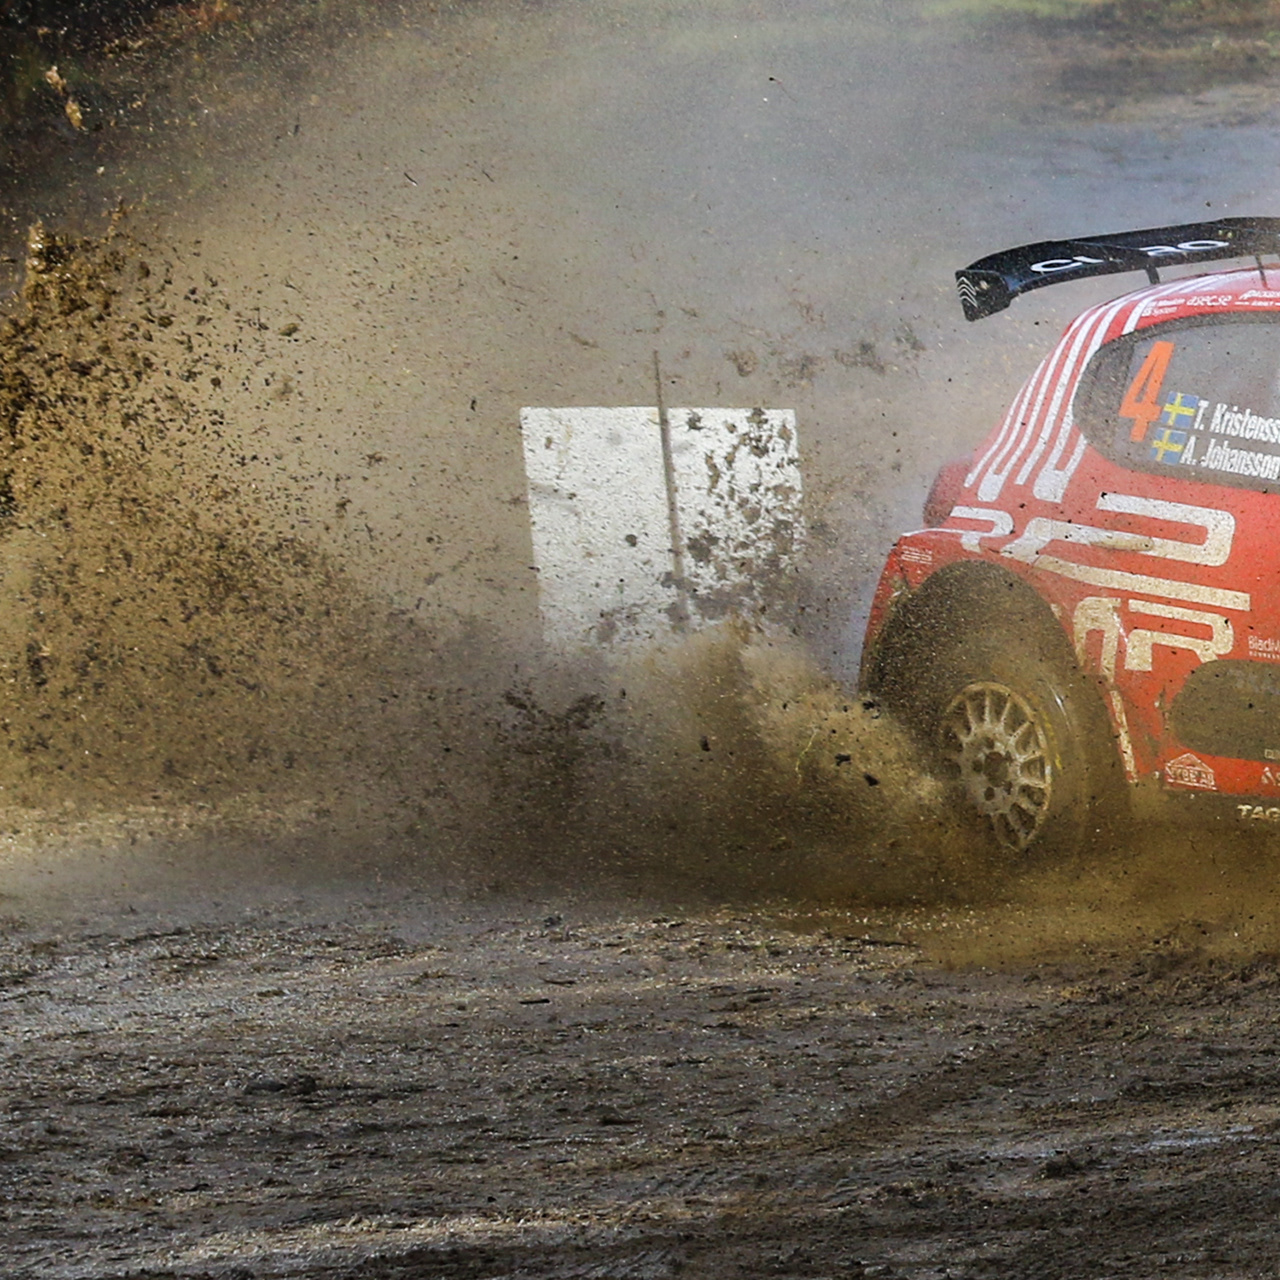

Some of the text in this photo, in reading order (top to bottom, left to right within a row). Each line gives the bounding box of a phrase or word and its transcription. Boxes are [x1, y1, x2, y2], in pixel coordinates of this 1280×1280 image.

[1118, 340, 1175, 442] 4
[1194, 399, 1210, 431] T.
[1180, 435, 1197, 466] A.
